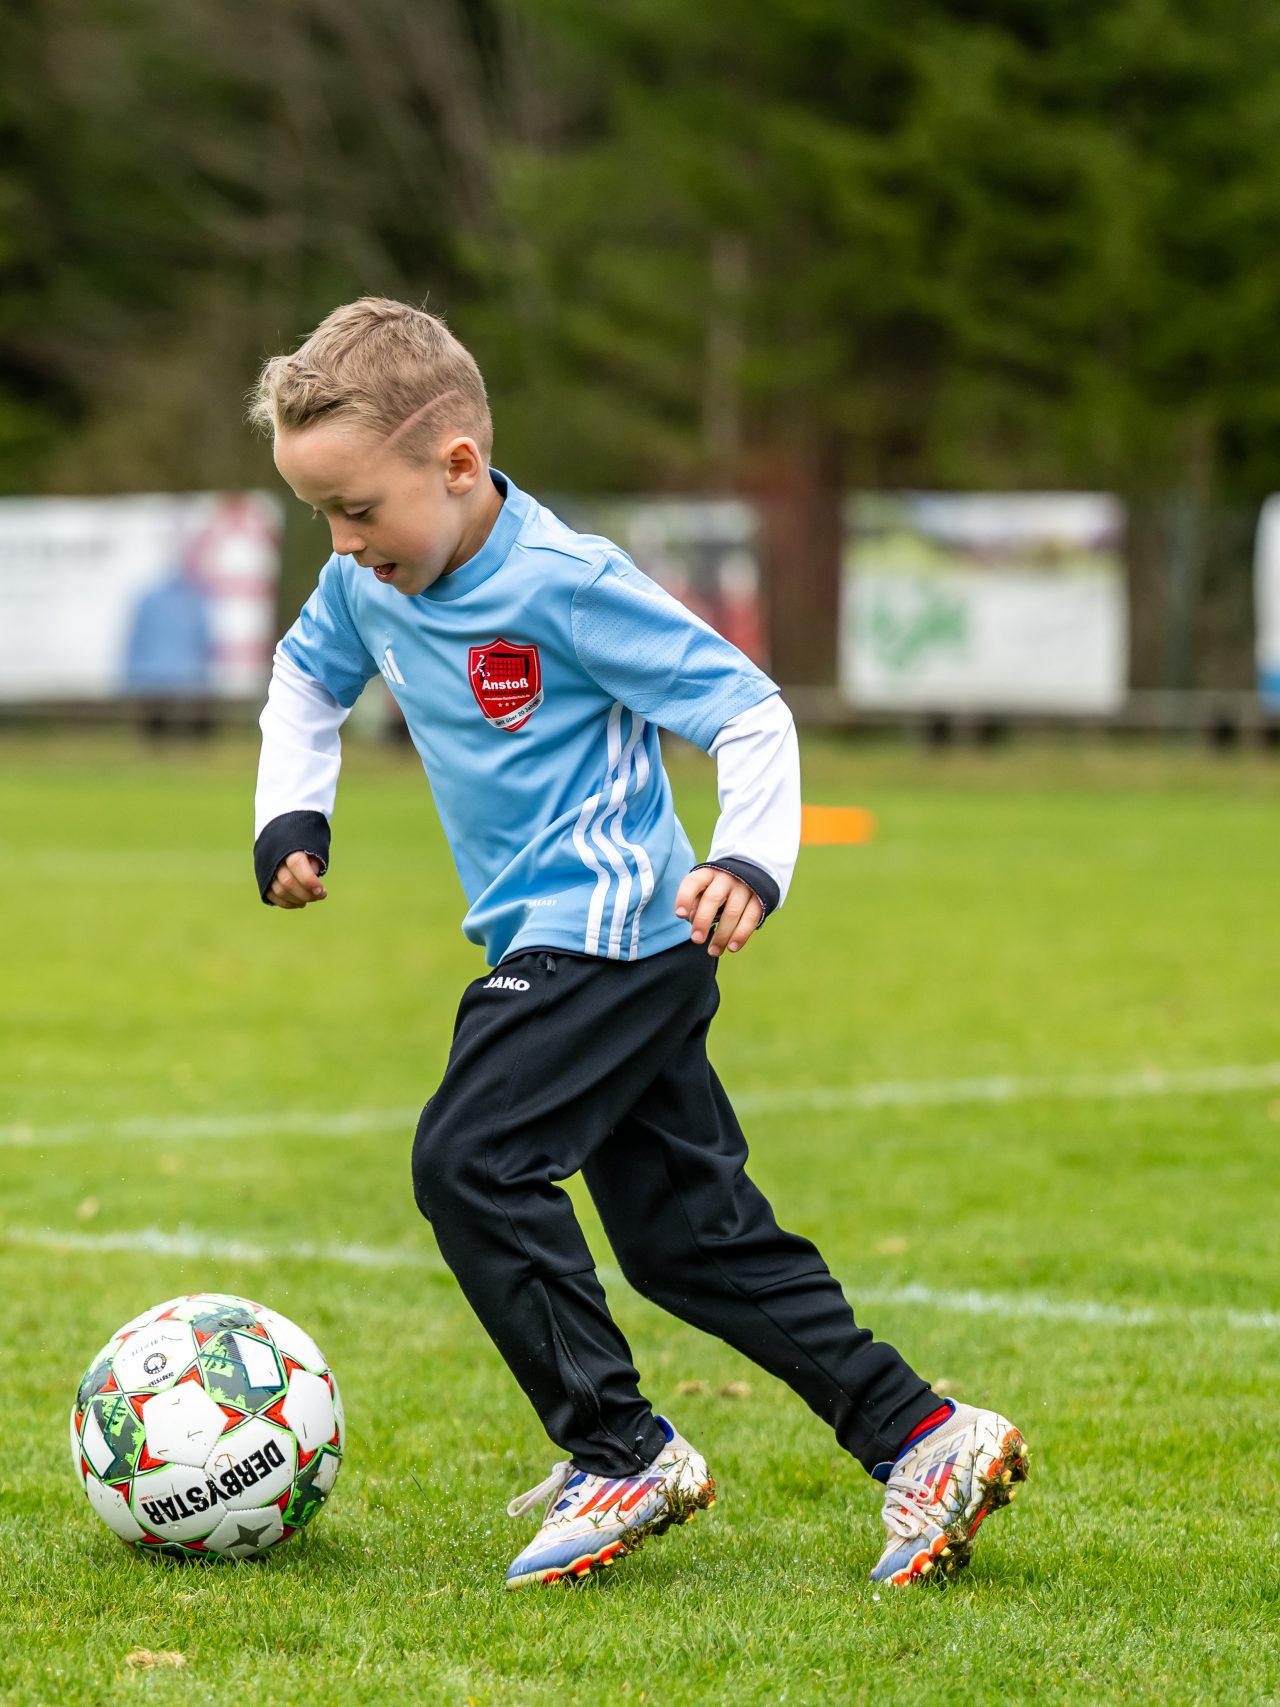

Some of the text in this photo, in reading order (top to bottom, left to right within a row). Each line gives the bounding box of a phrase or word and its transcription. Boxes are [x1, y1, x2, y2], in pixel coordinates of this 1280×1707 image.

[482, 678, 529, 690] Anstoß
[505, 714, 517, 723] über
[524, 699, 540, 713] Jahren
[483, 976, 530, 991] JAKO
[141, 1439, 286, 1526] DERBYSTAR
